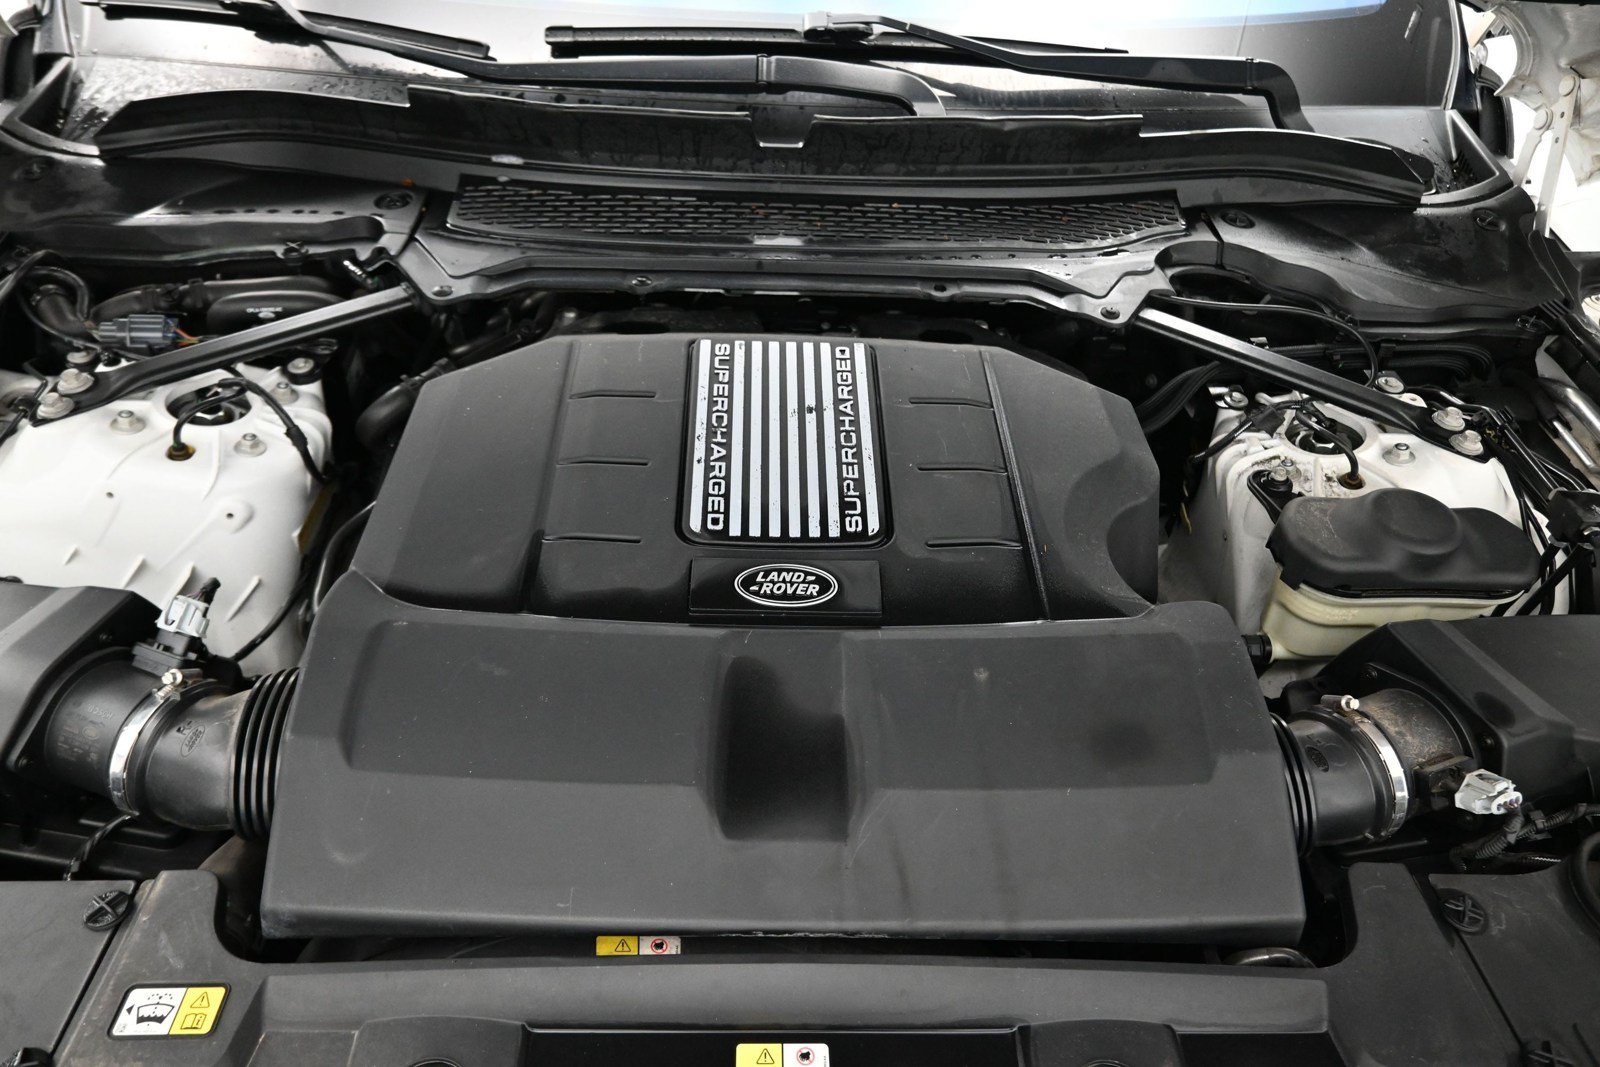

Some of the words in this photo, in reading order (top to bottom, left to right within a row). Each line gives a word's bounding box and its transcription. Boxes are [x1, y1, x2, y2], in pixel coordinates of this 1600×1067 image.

[706, 343, 731, 531] SUPERCHARGED
[835, 346, 863, 533] SUPERCHARGED
[755, 571, 806, 582] LAND
[759, 582, 820, 596] ROVER
